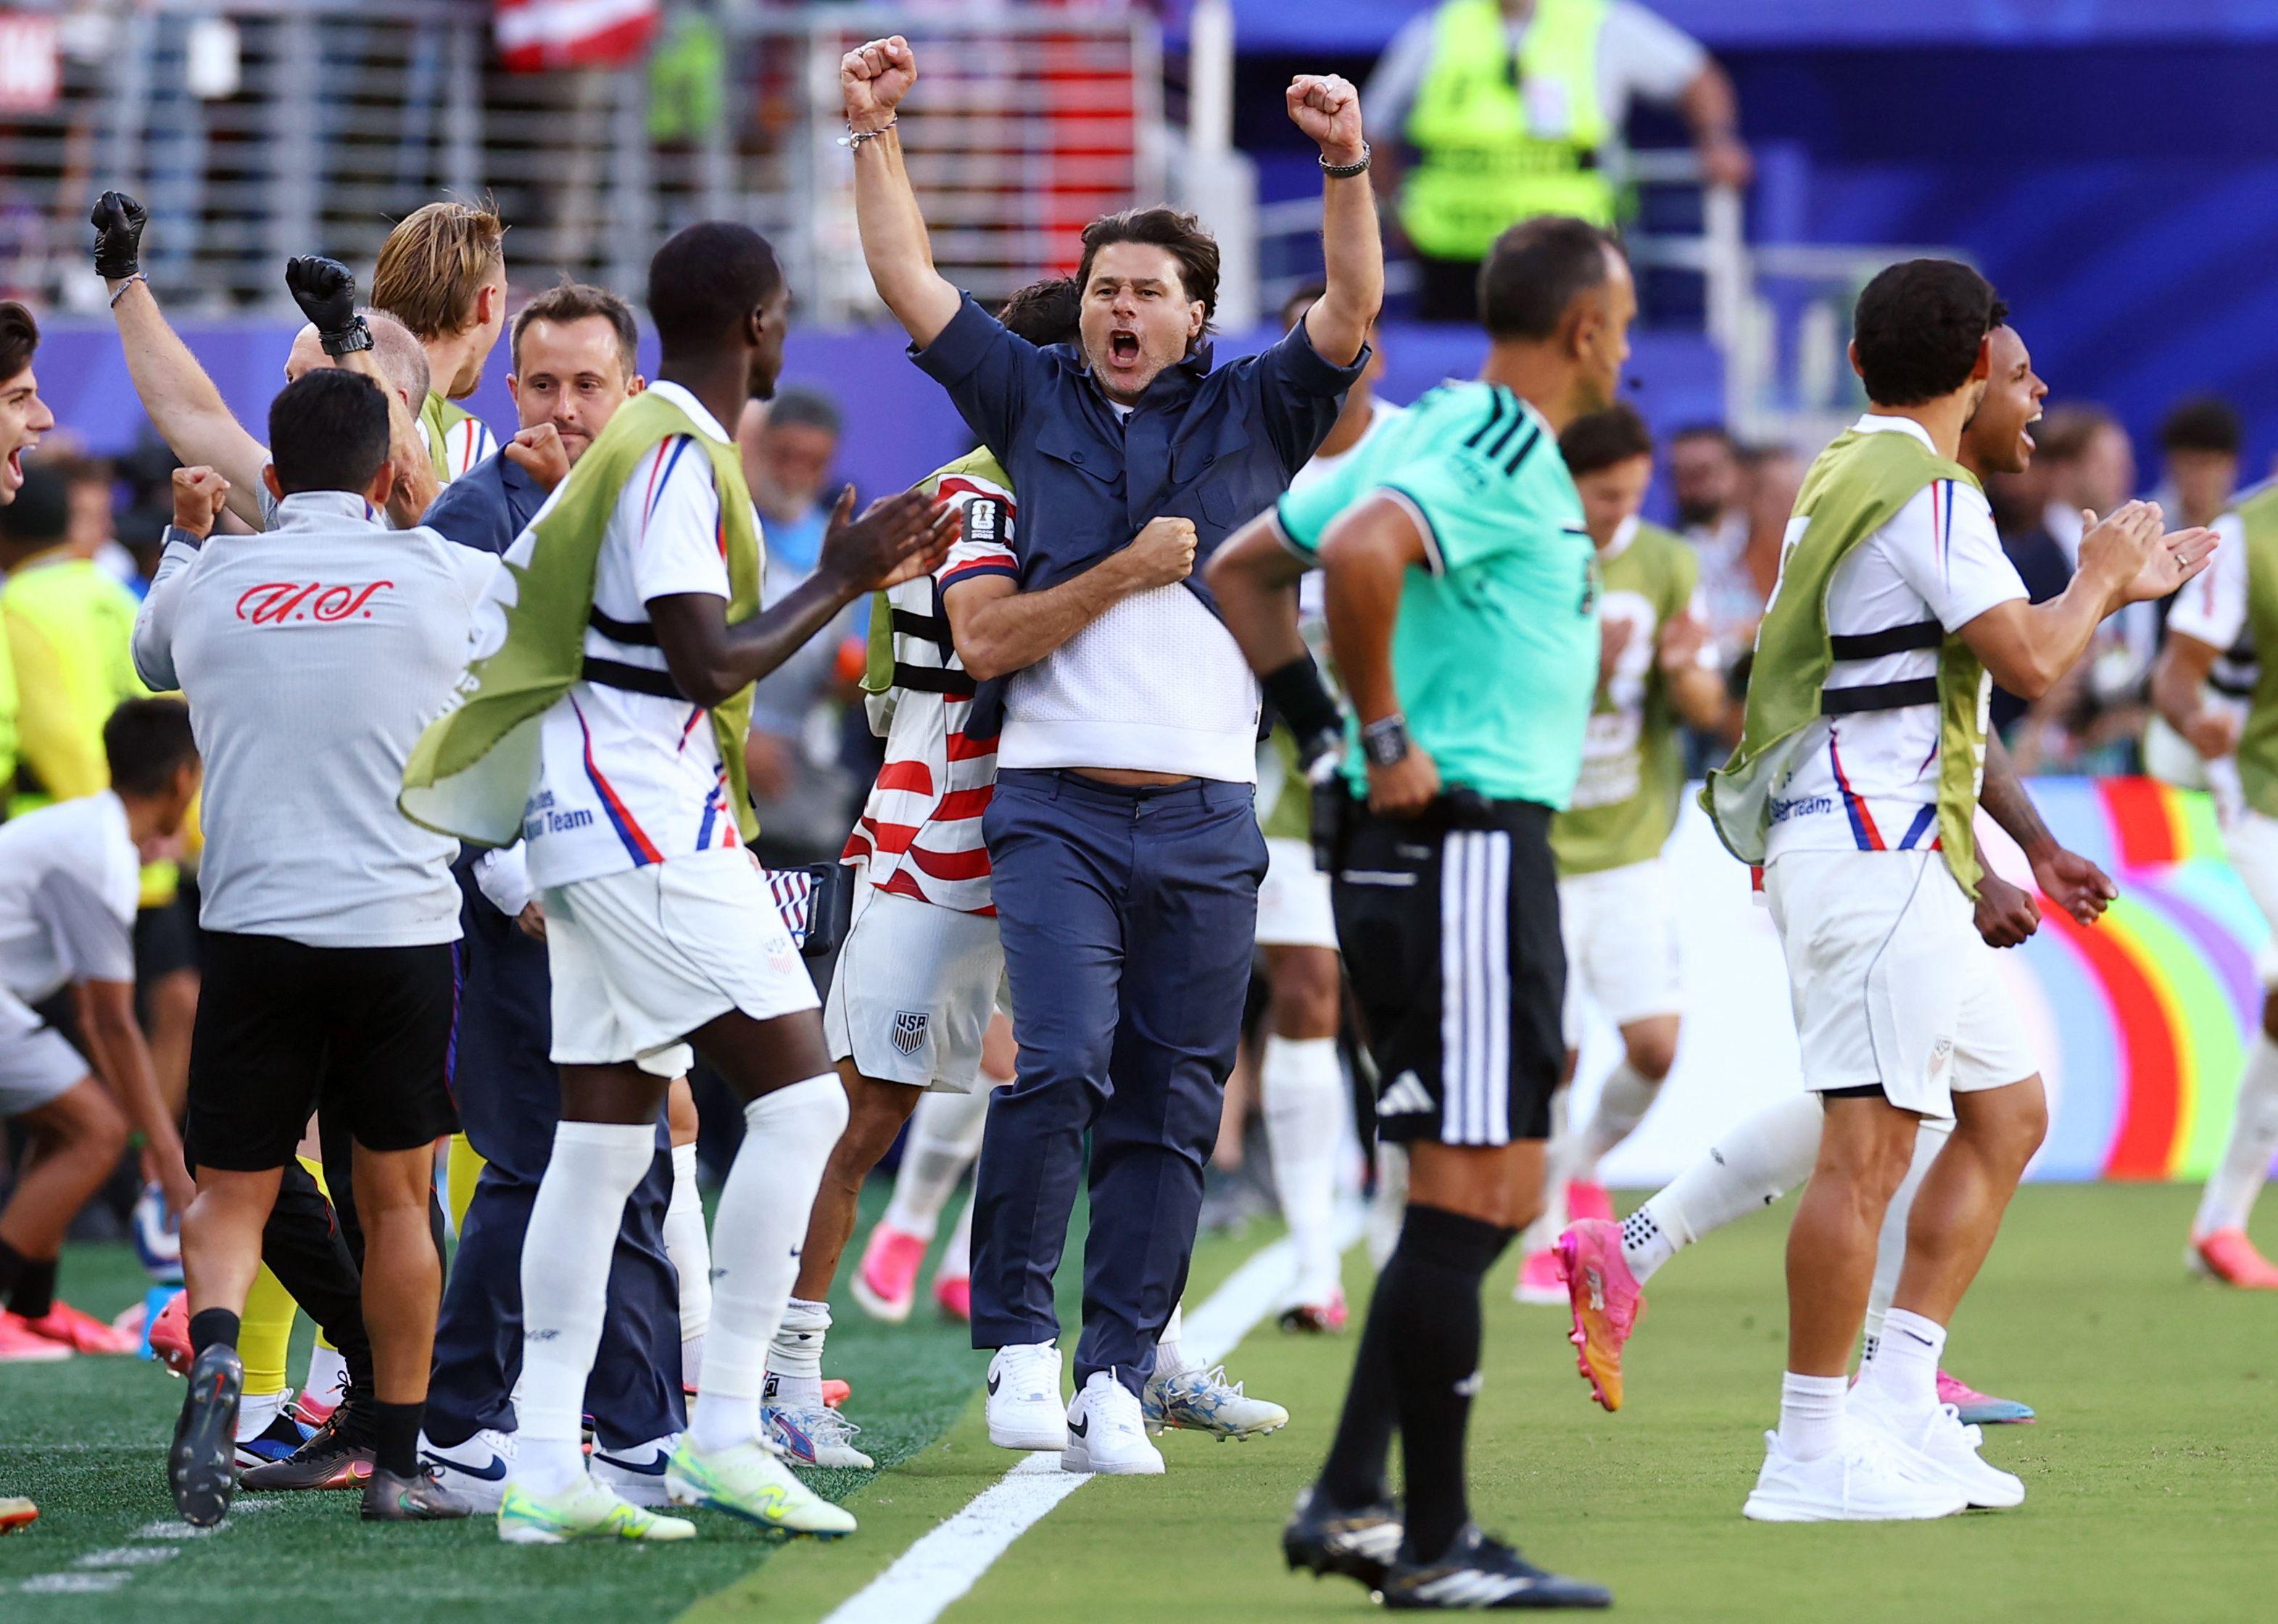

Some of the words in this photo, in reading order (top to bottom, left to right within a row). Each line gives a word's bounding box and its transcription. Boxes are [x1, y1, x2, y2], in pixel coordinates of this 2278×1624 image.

[236, 580, 394, 624] U.S.
[547, 808, 593, 833] Team
[898, 1014, 927, 1032] USA
